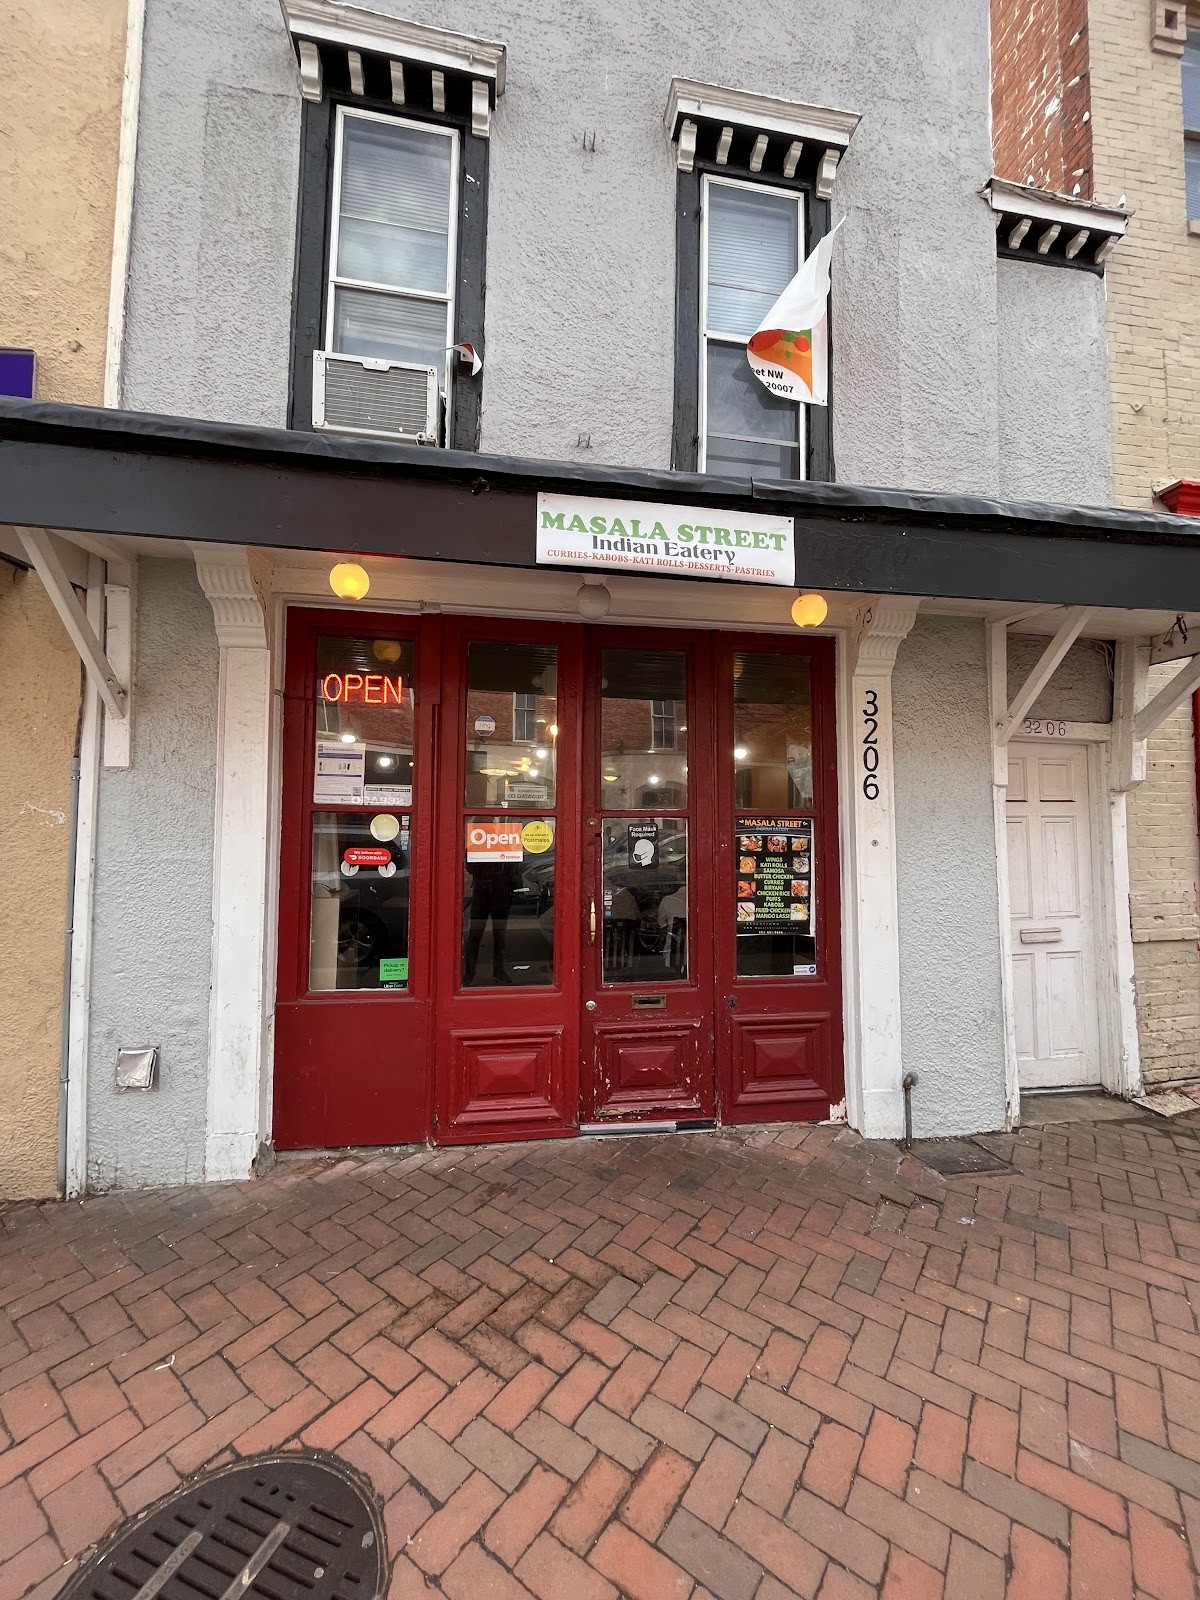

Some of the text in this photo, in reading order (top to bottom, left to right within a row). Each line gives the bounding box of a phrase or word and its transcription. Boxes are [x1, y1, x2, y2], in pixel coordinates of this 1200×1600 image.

[767, 369, 784, 379] NW
[765, 381, 794, 393] 20007
[540, 511, 787, 551] MASALA STREET
[592, 535, 736, 565] Indian Eatery
[322, 673, 403, 704] OPEN
[1023, 720, 1067, 736] 3206
[862, 690, 880, 801] 3206
[744, 819, 802, 828] MASALA STREET
[470, 828, 520, 849] Open
